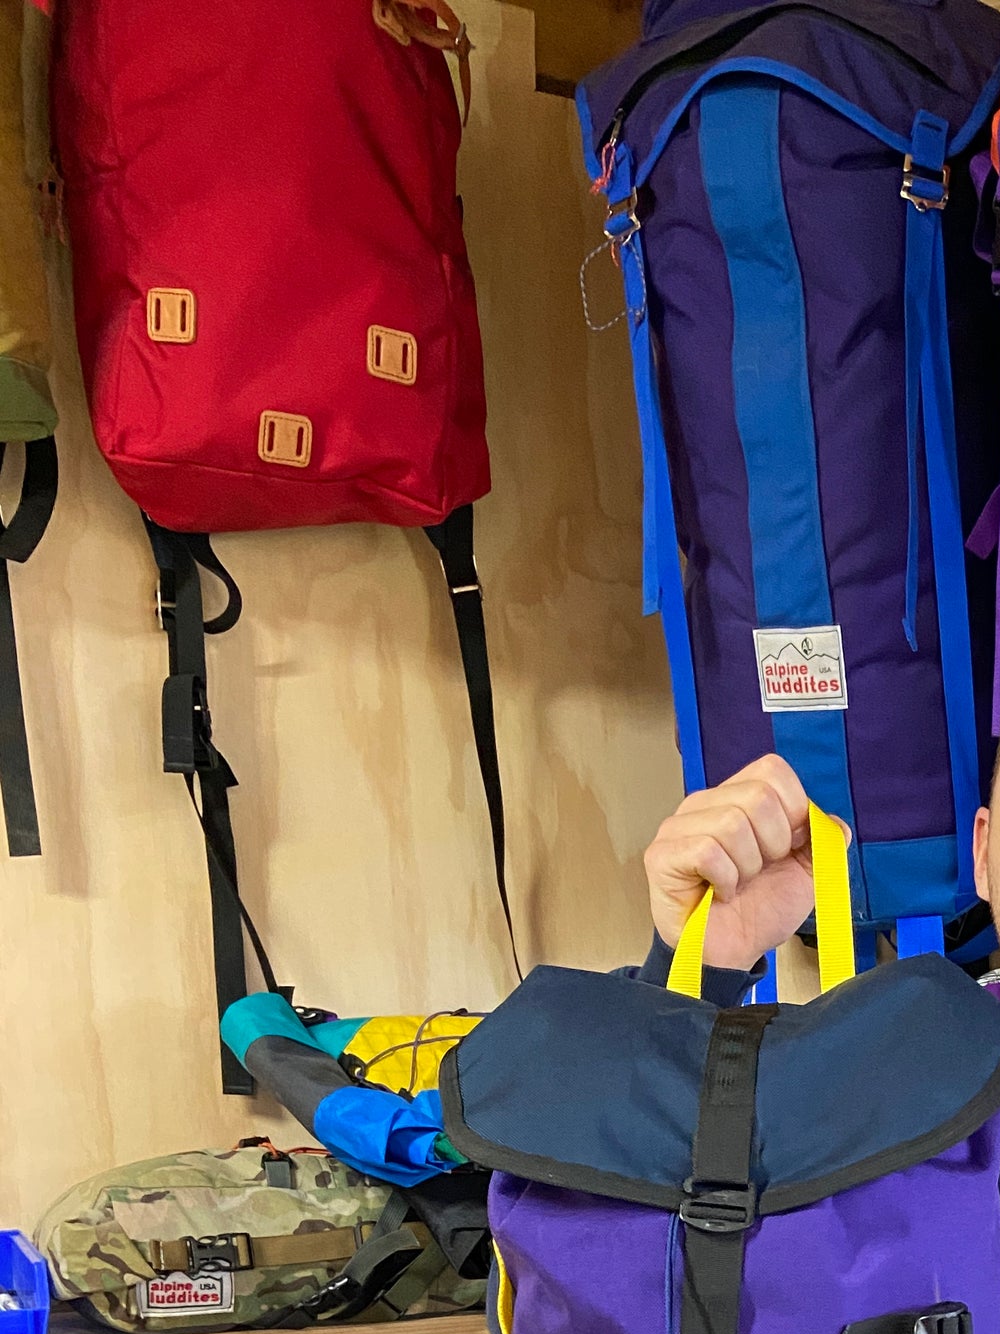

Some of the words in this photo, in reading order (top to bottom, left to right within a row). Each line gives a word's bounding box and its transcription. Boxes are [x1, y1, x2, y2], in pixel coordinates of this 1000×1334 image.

[765, 663, 808, 678] alpine
[766, 676, 839, 693] luddites
[150, 1282, 193, 1293] alpine
[150, 1291, 219, 1303] luddites
